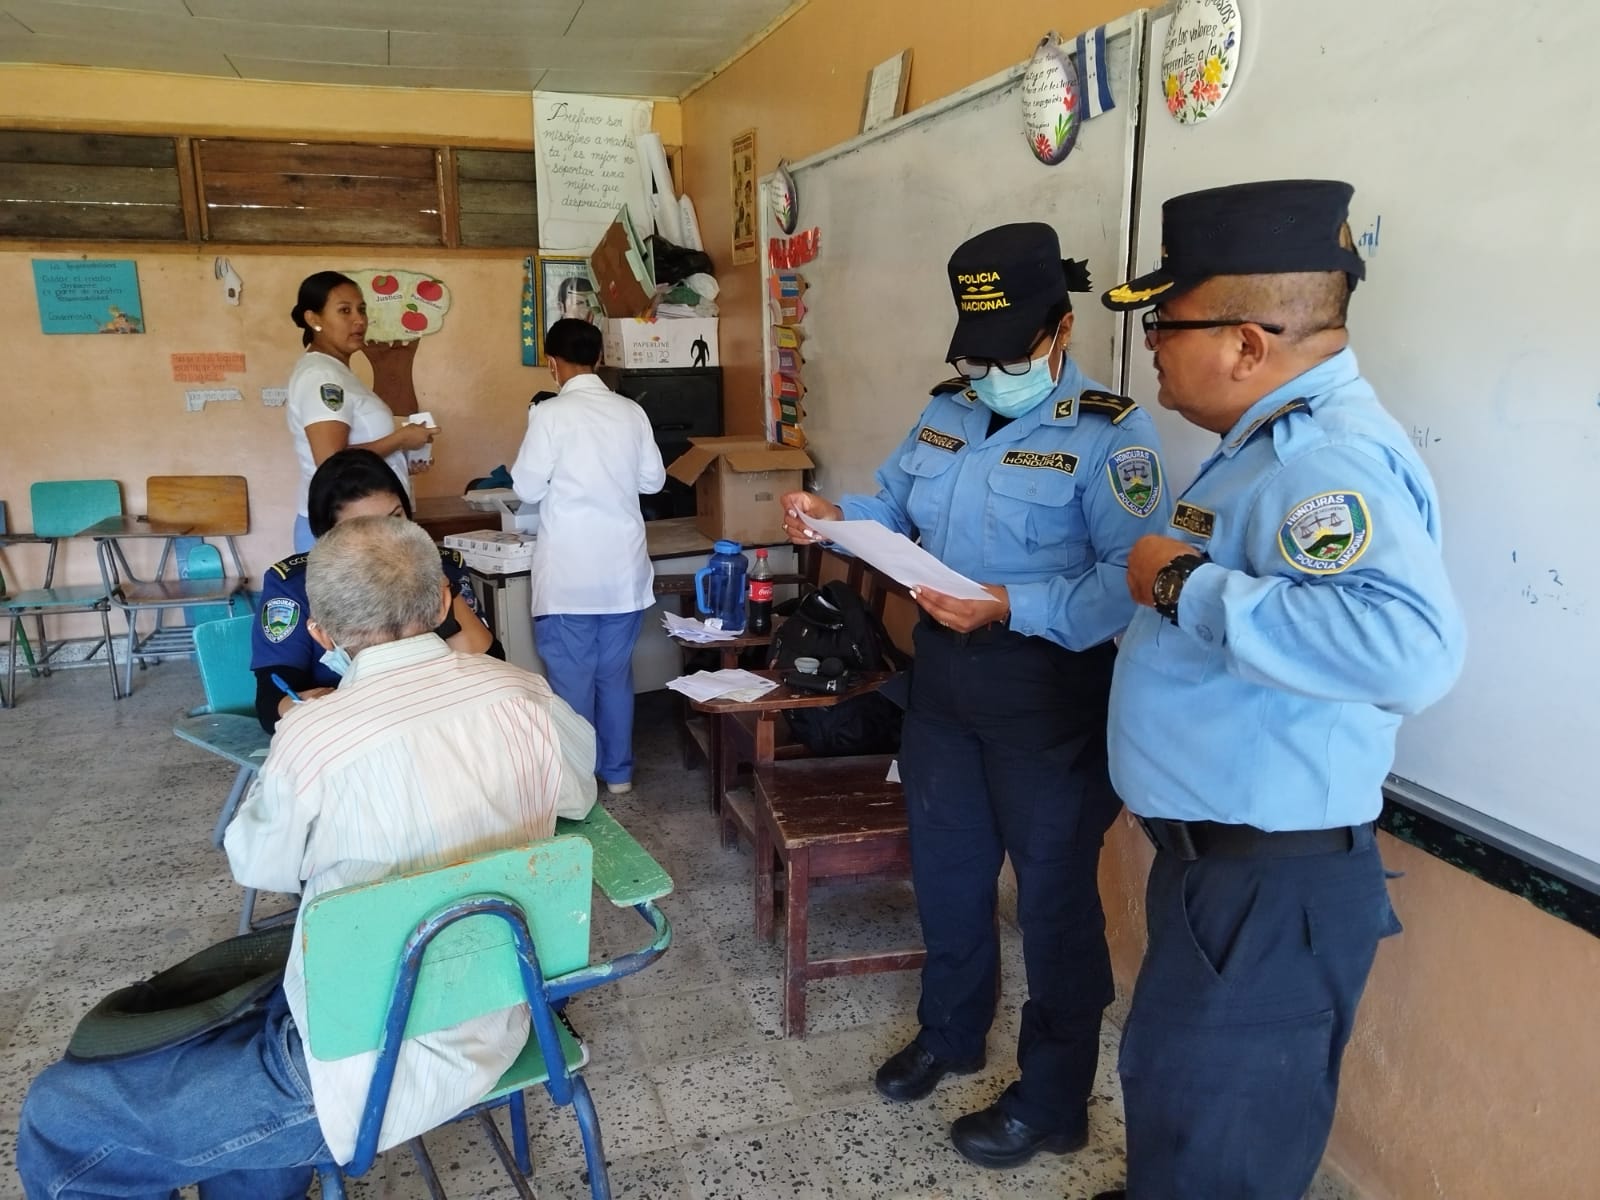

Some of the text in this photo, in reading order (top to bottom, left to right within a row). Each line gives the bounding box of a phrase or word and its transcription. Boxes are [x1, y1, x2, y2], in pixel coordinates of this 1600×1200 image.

[1189, 18, 1217, 43] valores
[1197, 49, 1205, 61] a
[1206, 39, 1217, 59] la
[547, 102, 623, 132] Prefiero ser
[594, 136, 602, 145] a
[573, 150, 586, 160] es
[552, 162, 625, 179] soportar una
[602, 184, 620, 199] que
[957, 271, 1000, 284] POLICIA
[376, 294, 403, 303] Justicia
[961, 298, 1011, 311] NACIONAL
[1005, 457, 1072, 472] HONDURAS
[1017, 452, 1064, 462] POLICIA
[1114, 450, 1150, 464] HONDURAS
[1118, 492, 1143, 514] POLICIA
[1286, 495, 1345, 526] HONDURAS
[1295, 529, 1366, 569] POLICIA NACIONAL
